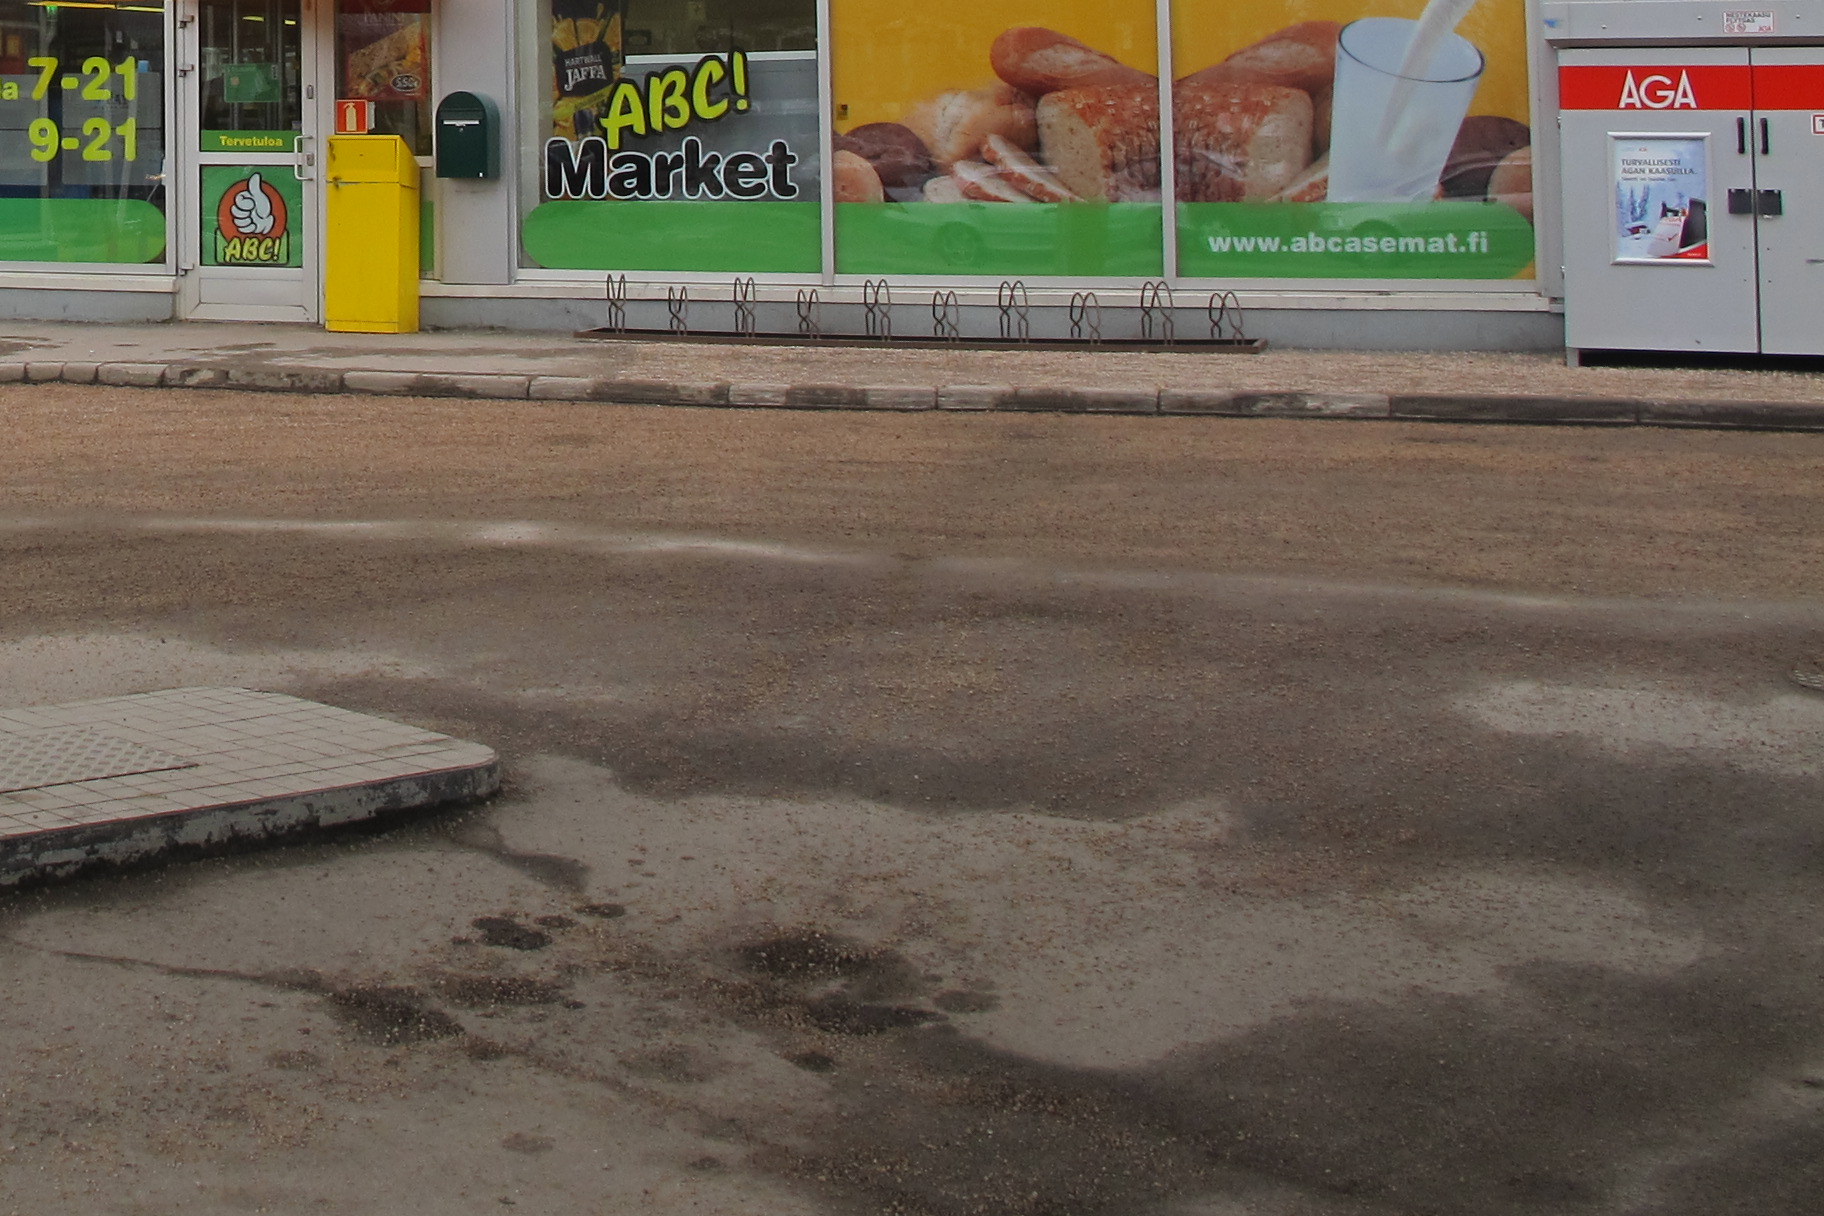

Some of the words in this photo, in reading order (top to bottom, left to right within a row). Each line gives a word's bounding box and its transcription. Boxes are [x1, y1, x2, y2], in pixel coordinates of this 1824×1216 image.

[28, 56, 136, 101] 7-21
[564, 65, 607, 91] JAFFA
[1618, 69, 1697, 109] AGA
[598, 50, 749, 150] ABC!
[29, 117, 137, 161] 9-21
[219, 136, 284, 147] Tervetuloa
[545, 136, 799, 200] Market
[224, 237, 281, 262] ABC!
[1207, 231, 1488, 253] www.abcasemat.fi
